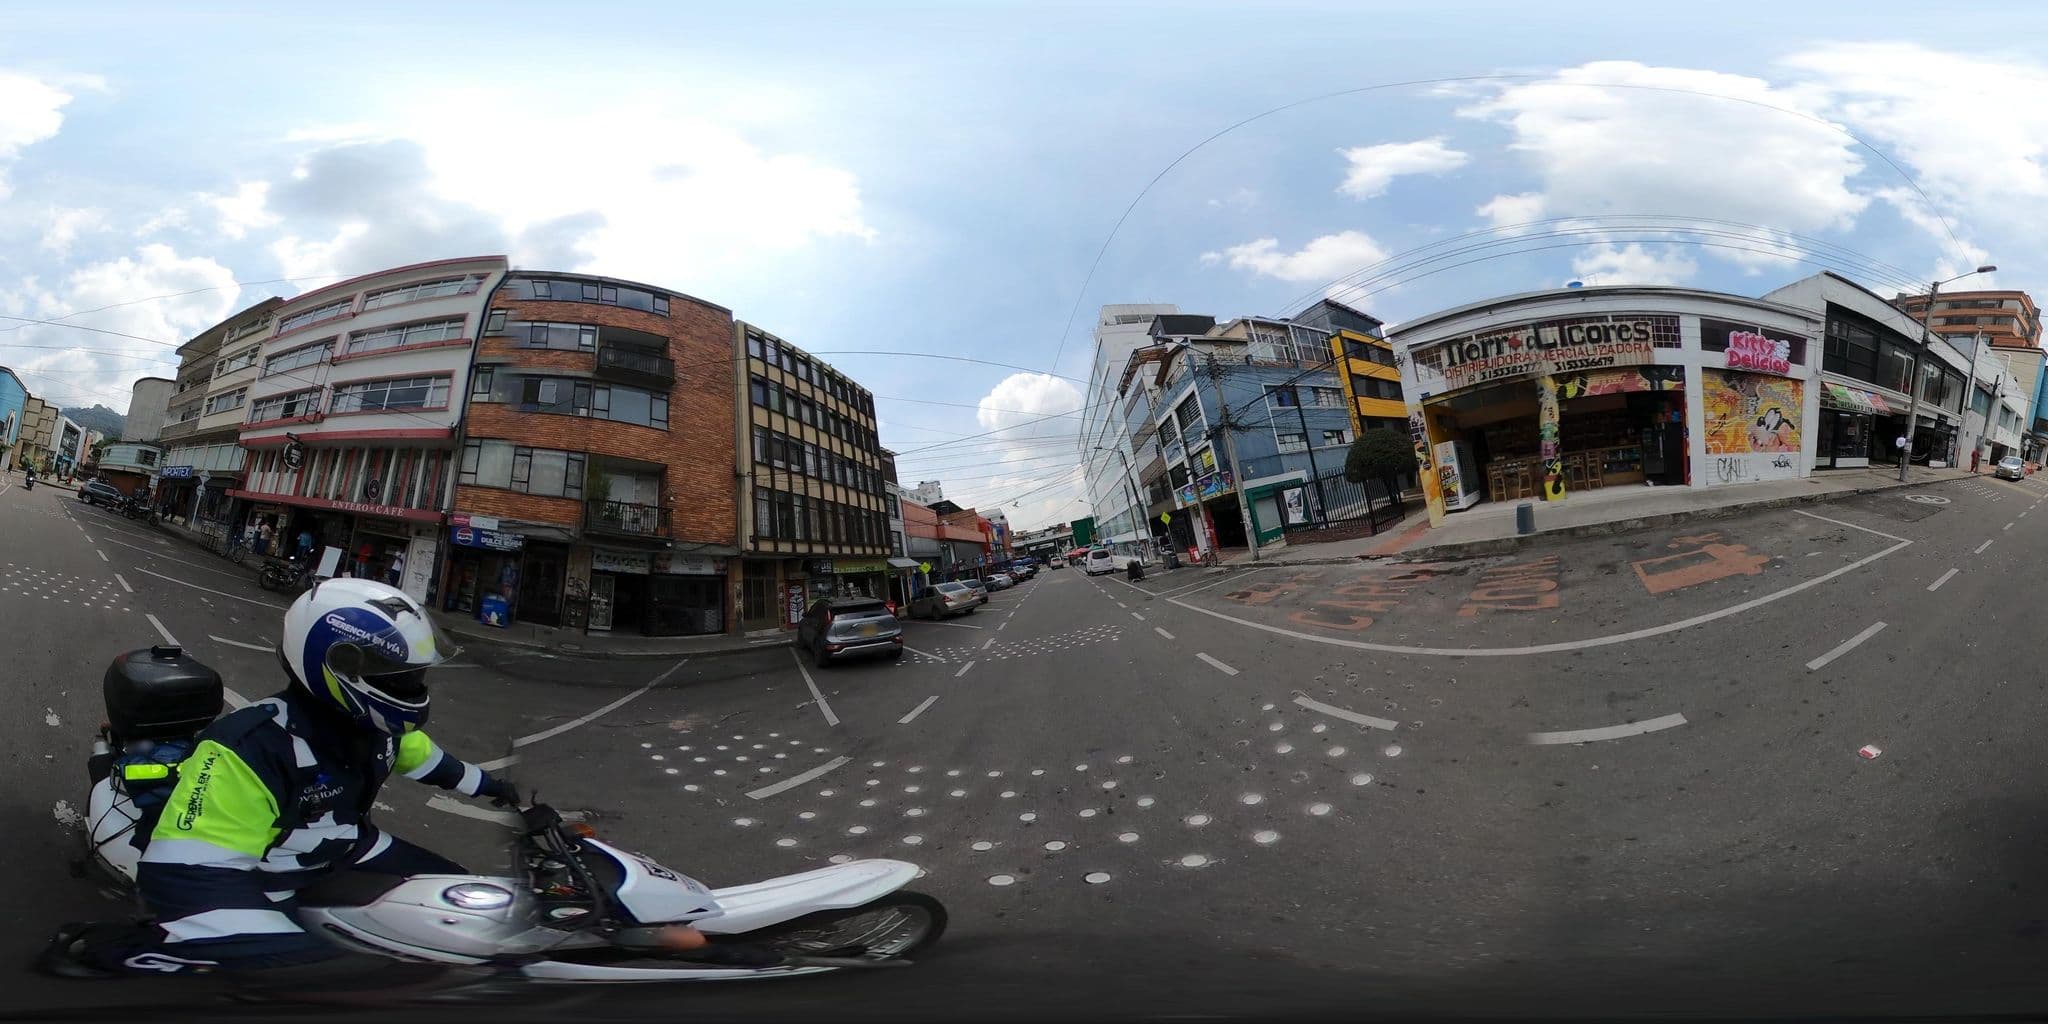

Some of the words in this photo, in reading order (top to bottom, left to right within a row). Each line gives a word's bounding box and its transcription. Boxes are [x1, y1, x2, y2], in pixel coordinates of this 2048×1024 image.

[1733, 333, 1776, 355] Kitty
[1444, 351, 1532, 379] DISTRIBUIDORA
[1727, 350, 1791, 374] Delicias
[326, 613, 371, 642] GERENCIA
[372, 635, 385, 647] EN
[177, 787, 203, 831] GERENCIA
[199, 769, 210, 786] EN
